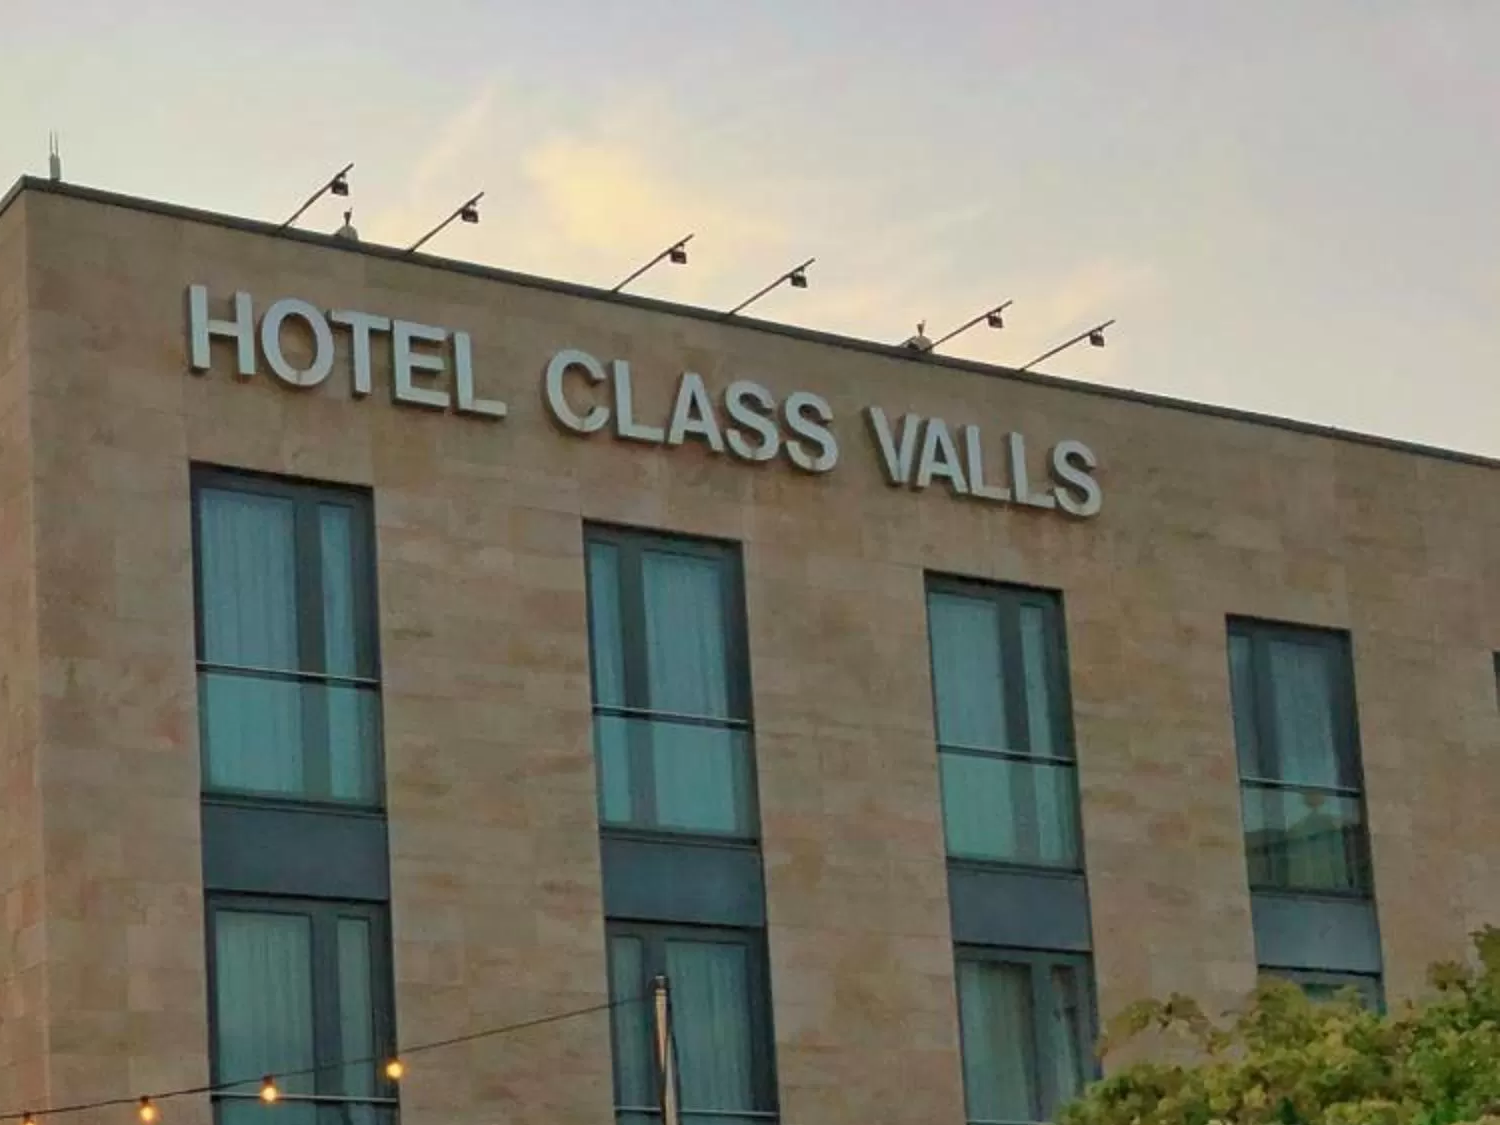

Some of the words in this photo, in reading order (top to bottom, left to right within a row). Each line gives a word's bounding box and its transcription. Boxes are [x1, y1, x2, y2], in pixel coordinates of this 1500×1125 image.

[187, 284, 507, 419] HOTEL
[545, 348, 839, 473] CLASS
[868, 406, 1102, 518] VALLS
